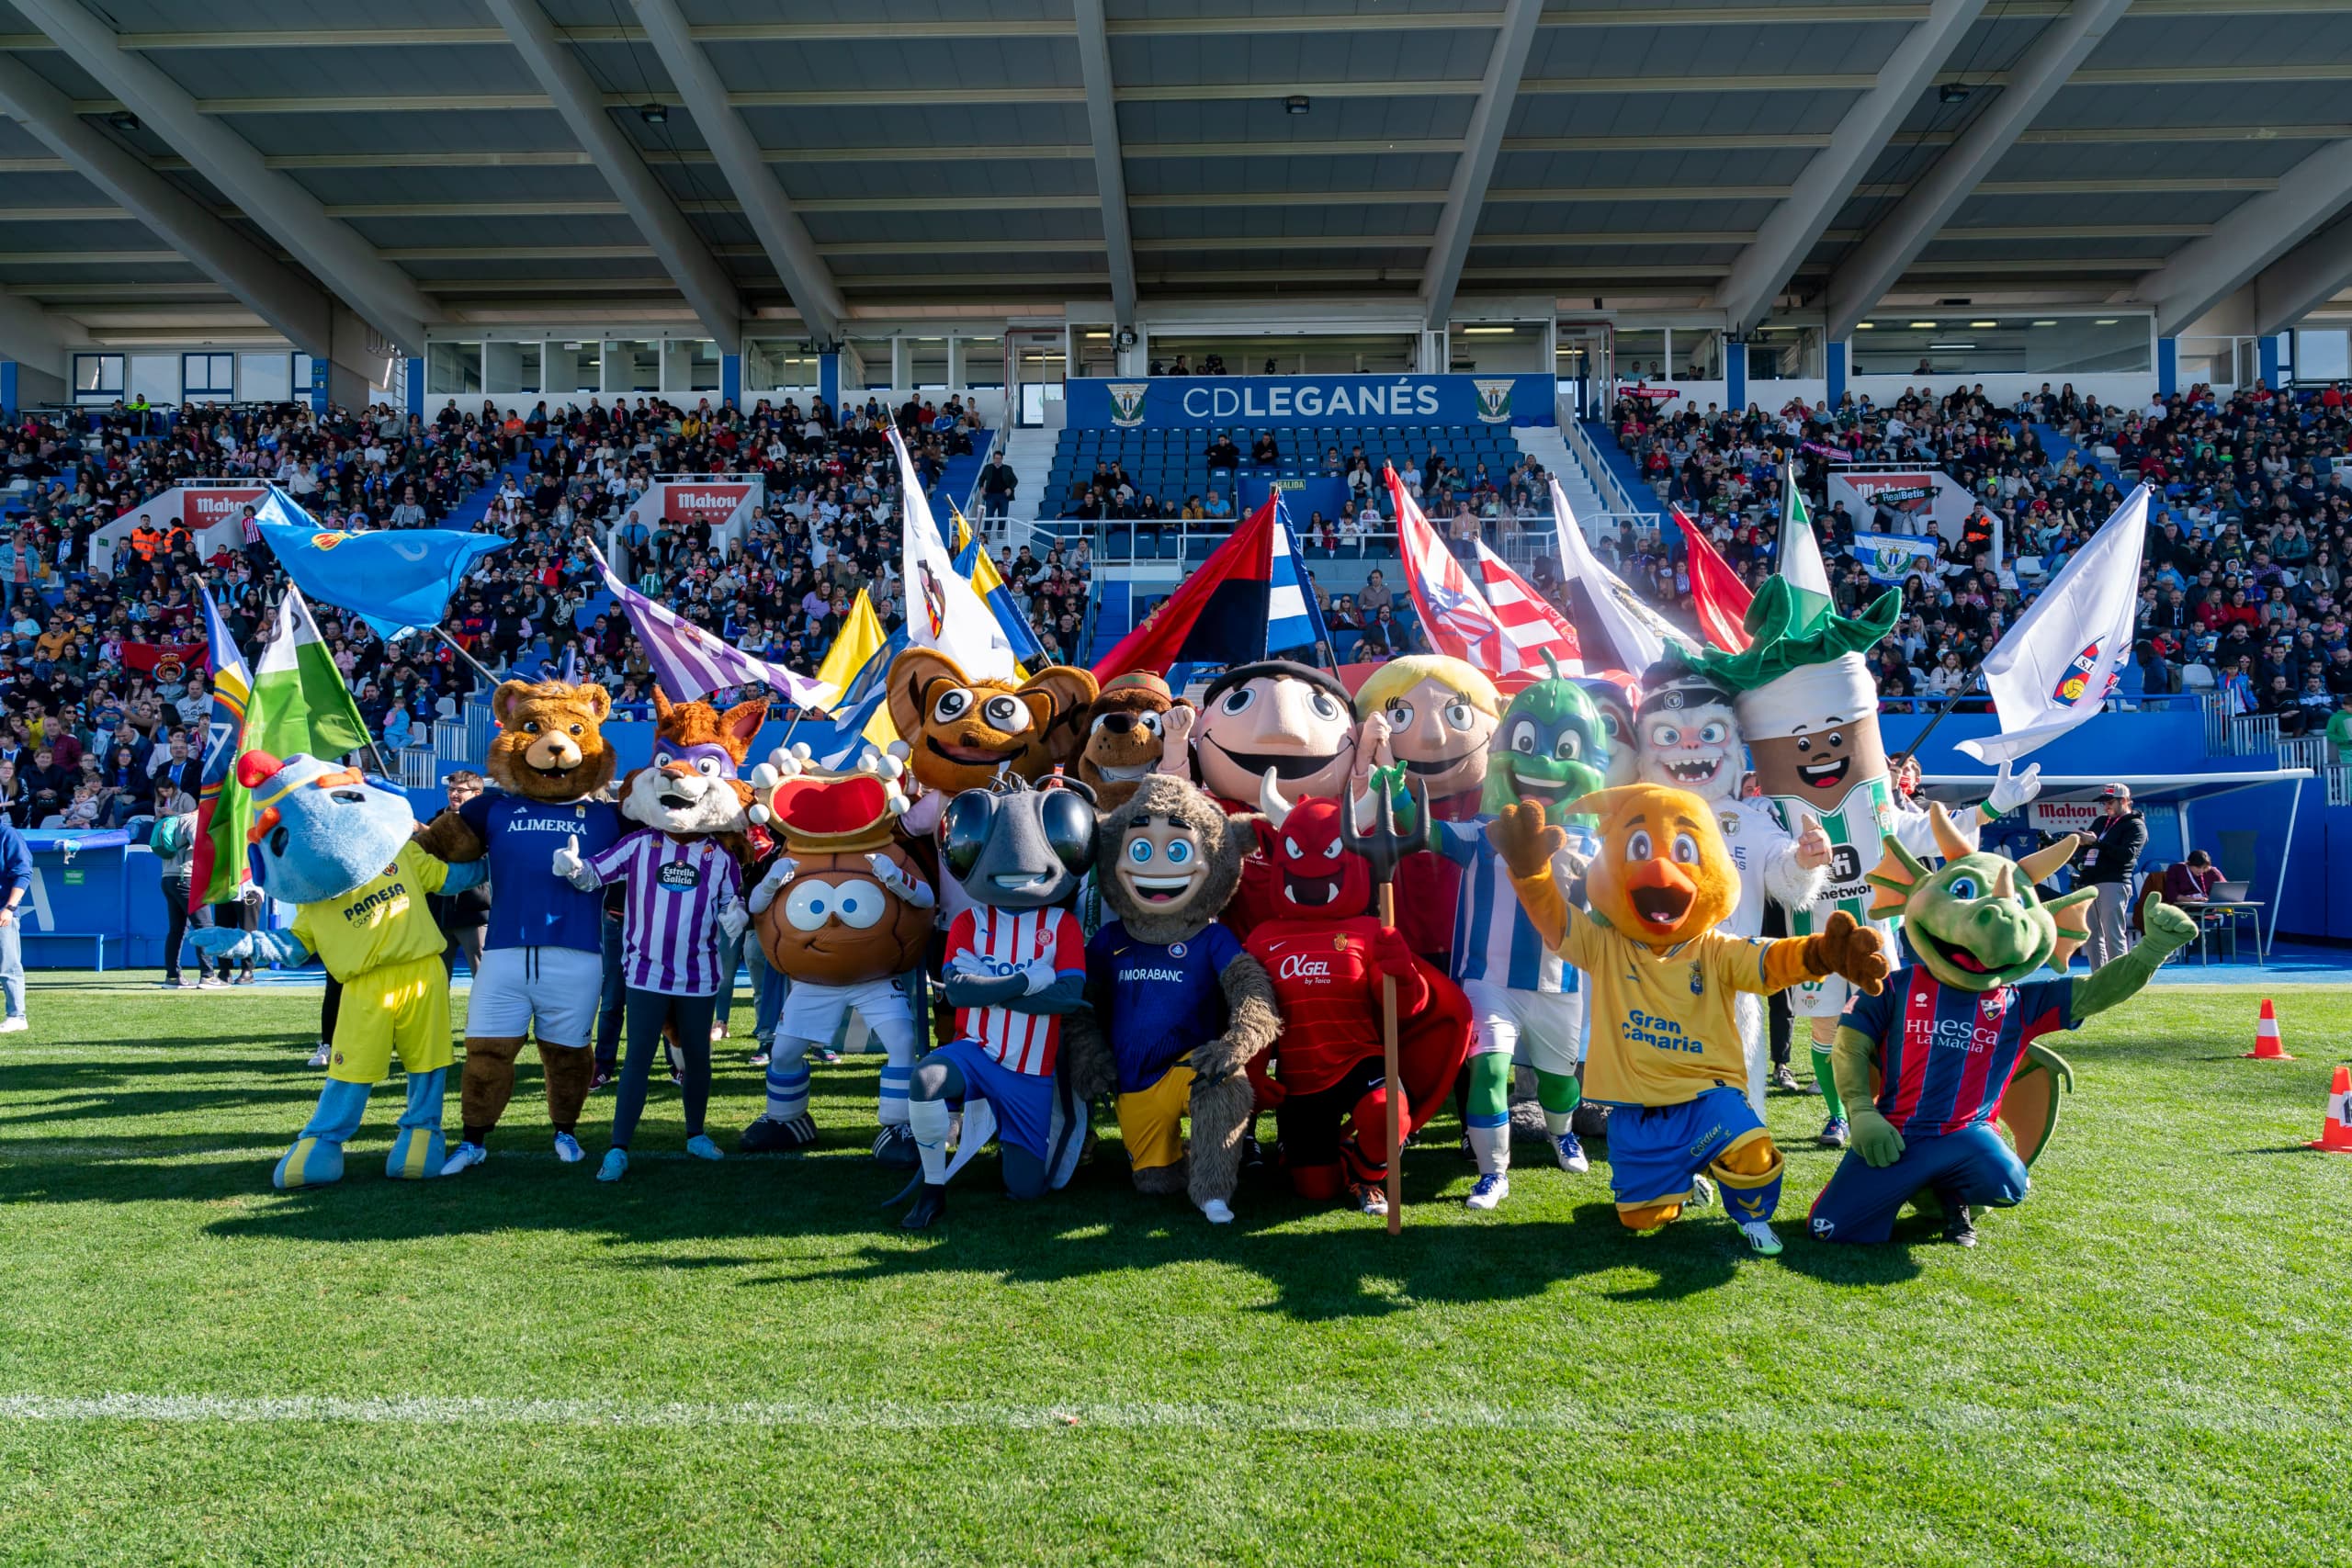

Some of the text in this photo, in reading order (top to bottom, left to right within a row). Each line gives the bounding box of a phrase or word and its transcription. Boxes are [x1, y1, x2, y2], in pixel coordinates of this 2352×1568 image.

[1856, 482, 1917, 499] Mah
[197, 497, 249, 513] Maho
[677, 492, 737, 509] Mahou
[2038, 802, 2098, 818] Mahou
[507, 818, 587, 835] ALIMERKA
[662, 866, 695, 877] Estrella
[662, 874, 693, 885] Galicia
[344, 883, 406, 921] PAMESA
[1629, 1009, 1681, 1035] Gran
[1622, 1021, 1703, 1055] Canaria
